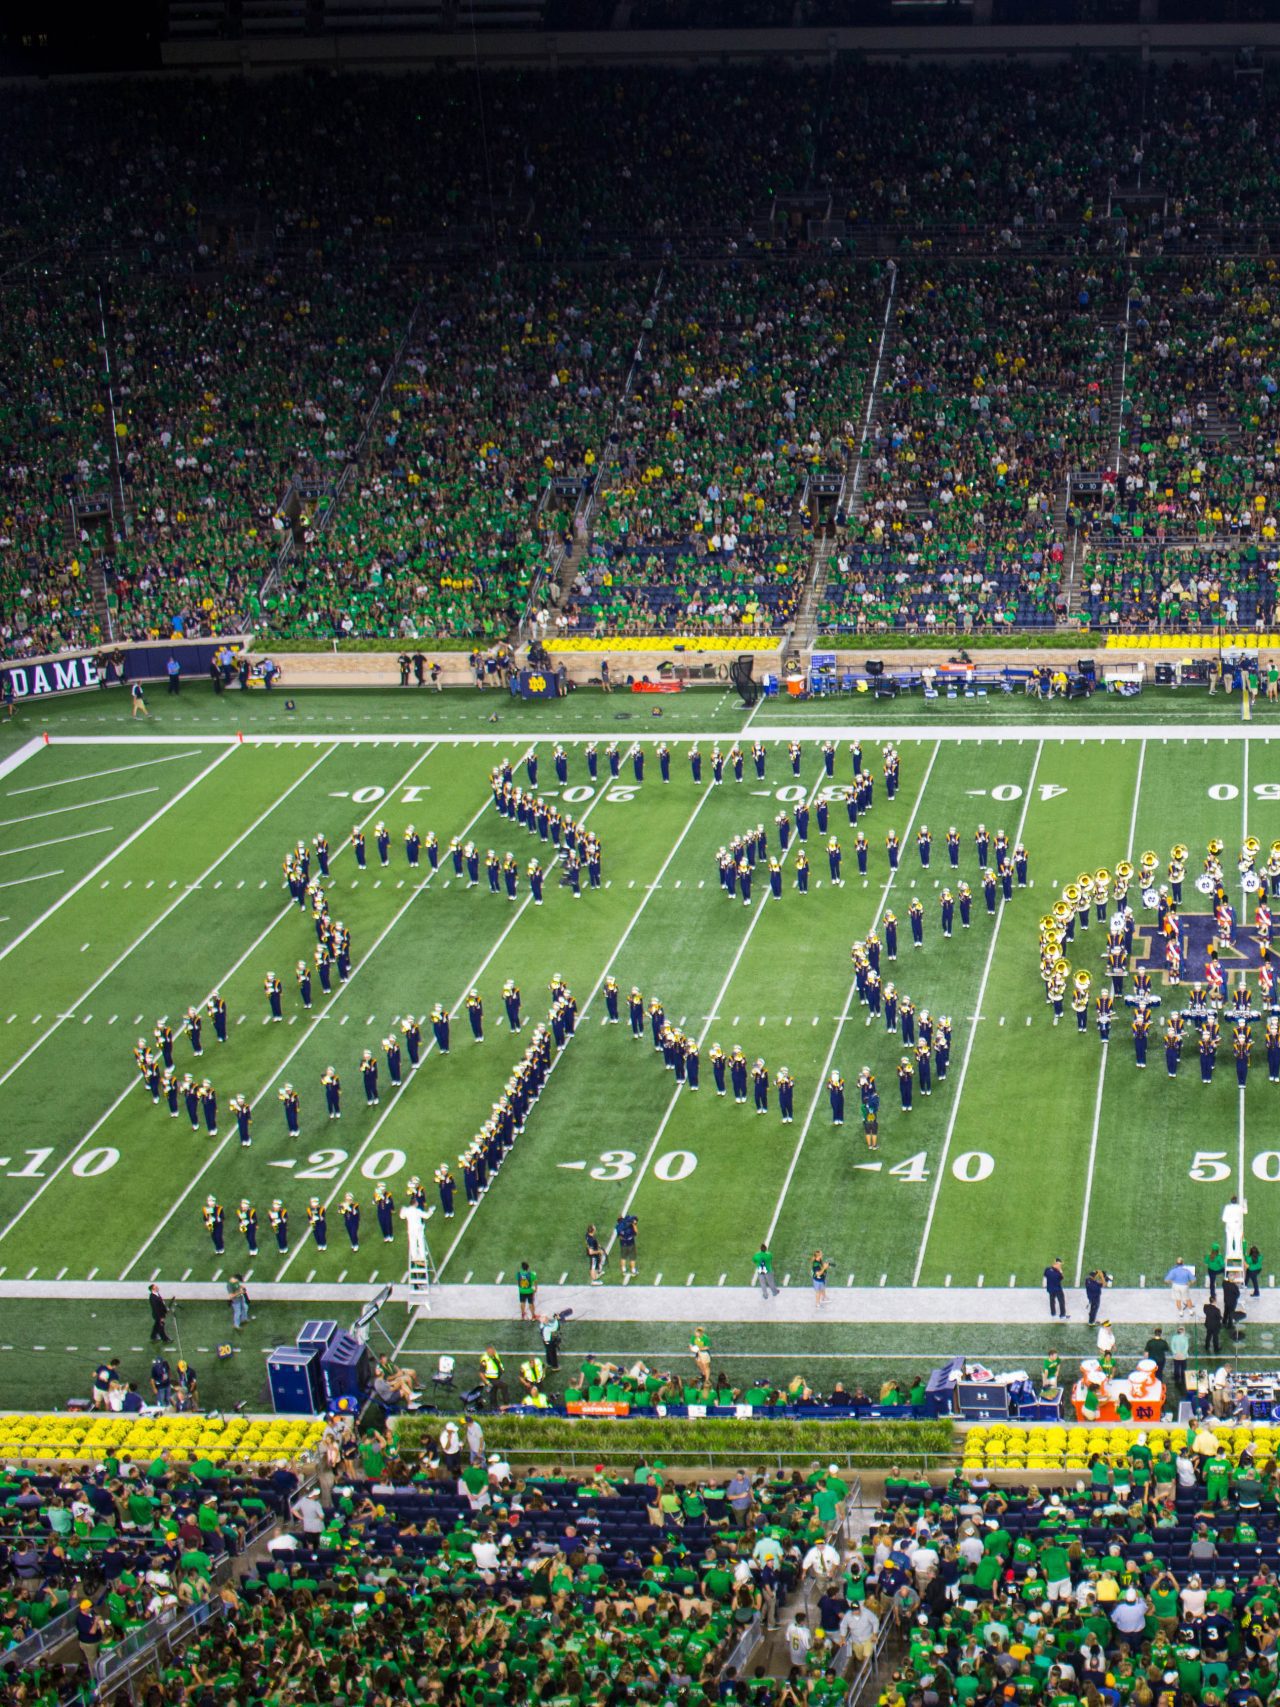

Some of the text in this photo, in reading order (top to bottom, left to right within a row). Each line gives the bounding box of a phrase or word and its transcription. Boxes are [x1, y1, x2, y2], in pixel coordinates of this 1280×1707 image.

[10, 656, 101, 697] DAME
[351, 786, 432, 803] 10
[562, 785, 641, 802] 20
[774, 784, 854, 802] 30
[990, 784, 1068, 801] 40
[8, 1147, 120, 1177] 10
[295, 1148, 406, 1180] 20
[590, 1149, 698, 1181] 30
[888, 1151, 995, 1183] 40
[218, 1345, 231, 1356] 20
[1207, 1628, 1219, 1641] 3
[792, 1636, 800, 1651] 6
